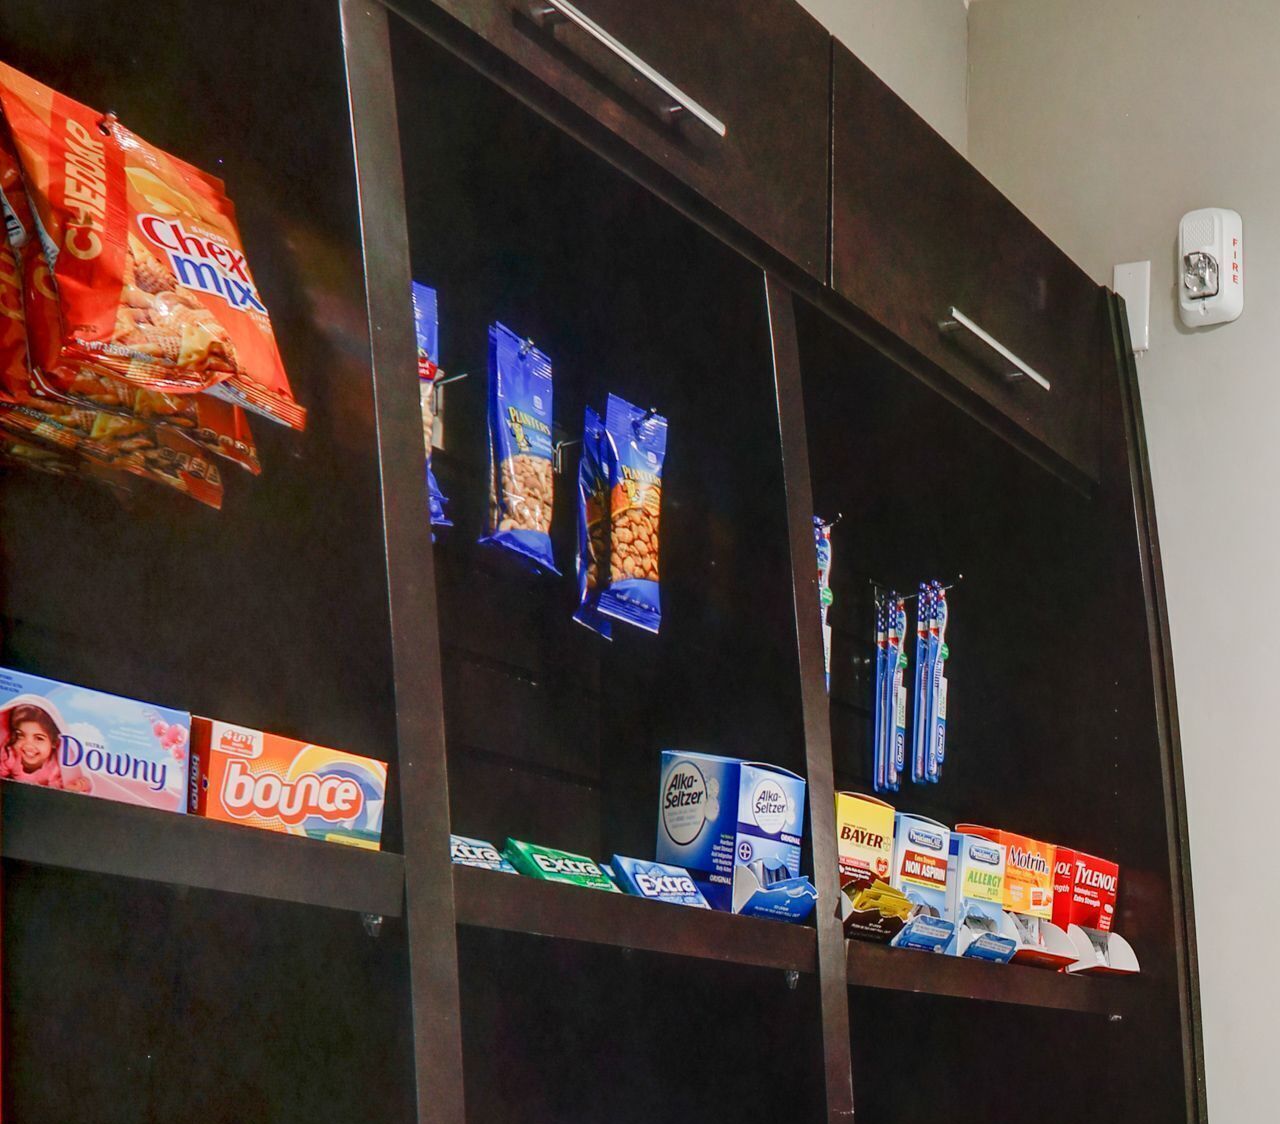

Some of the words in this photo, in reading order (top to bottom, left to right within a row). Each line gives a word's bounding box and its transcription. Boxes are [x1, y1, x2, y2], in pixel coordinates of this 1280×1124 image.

[64, 118, 108, 260] CHEDDAR
[143, 215, 247, 280] Chex
[1231, 237, 1240, 286] FIRE
[174, 250, 265, 311] mix
[60, 735, 167, 791] Downy
[226, 760, 361, 816] bounce
[668, 773, 698, 792] Alka-
[665, 790, 703, 809] Seltzer
[754, 802, 786, 814] Seltzer
[758, 790, 781, 802] Alka-
[840, 825, 883, 850] BAYER
[451, 845, 502, 862] xtra
[532, 854, 602, 877] Extra
[1008, 845, 1046, 873] Motrin
[905, 859, 921, 874] NON
[921, 863, 946, 882] ASPIRIN
[967, 870, 1001, 888] ALLERGY
[1075, 861, 1117, 892] TYLENOL
[636, 873, 696, 897] Extra
